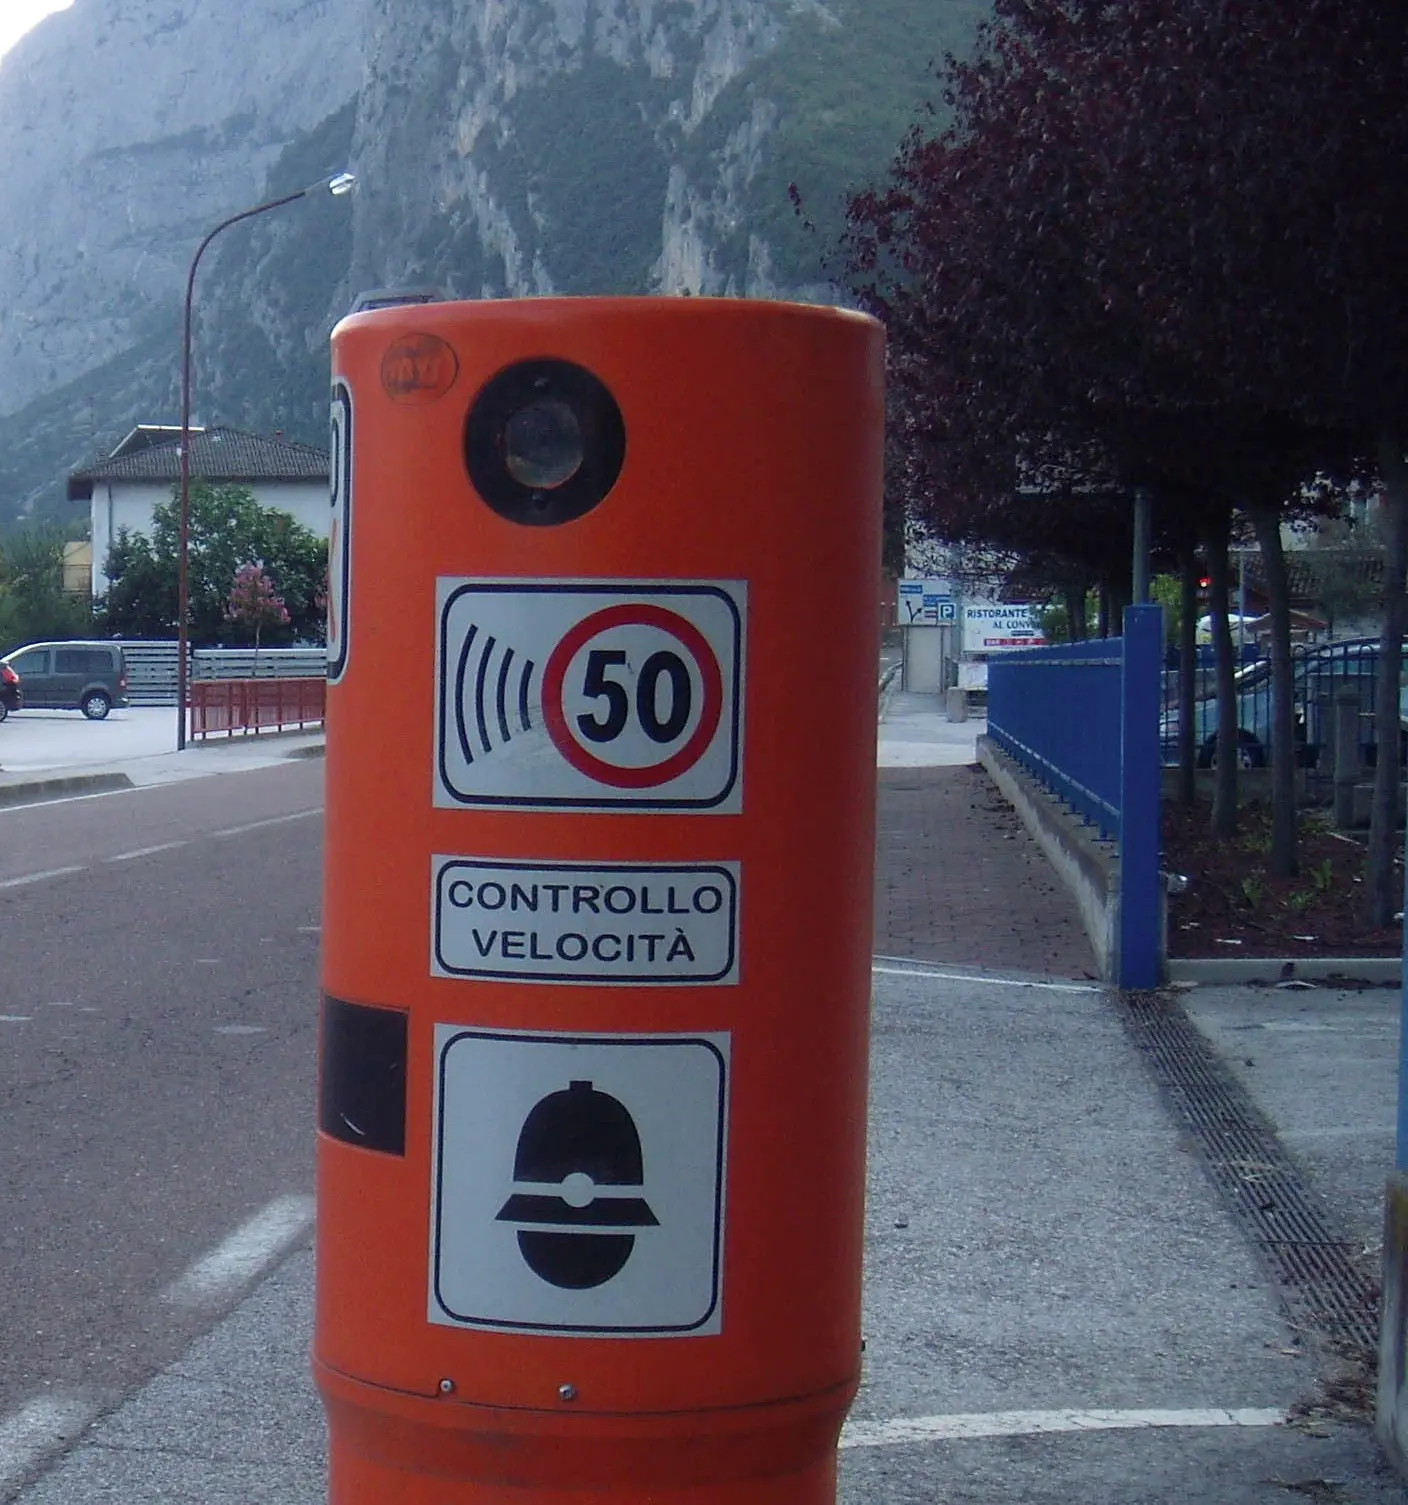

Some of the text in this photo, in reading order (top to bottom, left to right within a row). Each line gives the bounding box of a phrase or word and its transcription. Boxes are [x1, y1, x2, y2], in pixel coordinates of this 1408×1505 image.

[943, 607, 953, 618] P
[967, 608, 1028, 618] RISTORANTE
[577, 650, 691, 743] 50
[448, 880, 723, 914] CONTROLLO
[472, 928, 695, 962] VELOCITÀ
